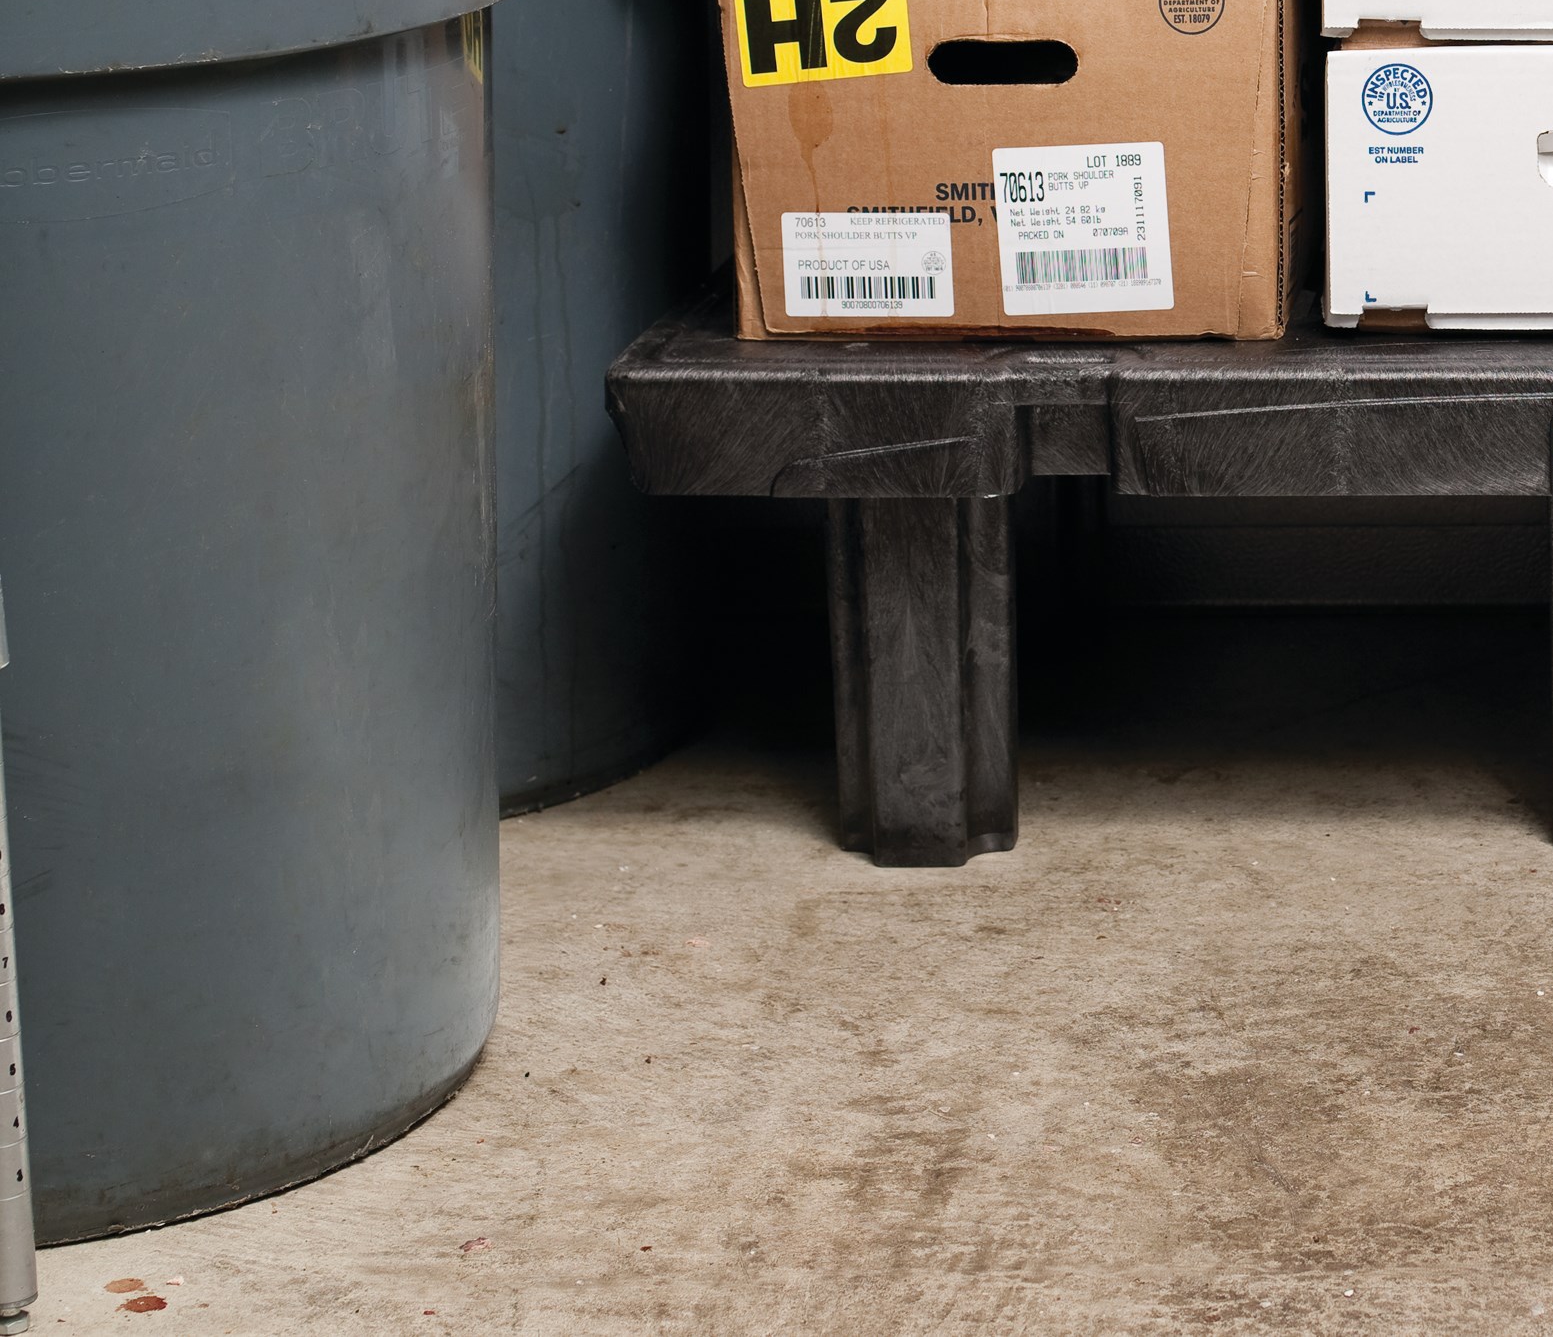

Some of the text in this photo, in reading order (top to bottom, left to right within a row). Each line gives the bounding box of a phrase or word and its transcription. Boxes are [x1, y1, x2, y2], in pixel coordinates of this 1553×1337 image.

[1188, 14, 1211, 24] 18079
[1366, 67, 1427, 99] INSPECTED
[1386, 92, 1411, 110] U.S.
[1368, 147, 1424, 155] EST NUMBER
[1086, 154, 1142, 168] LOT 1889
[1374, 156, 1418, 164] ON LABEL
[1048, 170, 1114, 181] PORK SHOULDER
[1000, 171, 1045, 203] 70613
[1048, 182, 1074, 191] BUTTS
[1030, 206, 1060, 217] Weight
[795, 217, 945, 228] 70613 KEEP REFRIGERATED
[1030, 216, 1061, 227] Weight
[795, 231, 918, 240] PORK SHOULDER BUTTS VP
[1018, 231, 1049, 240] PACKED
[798, 260, 890, 271] PRODUCT OF USA
